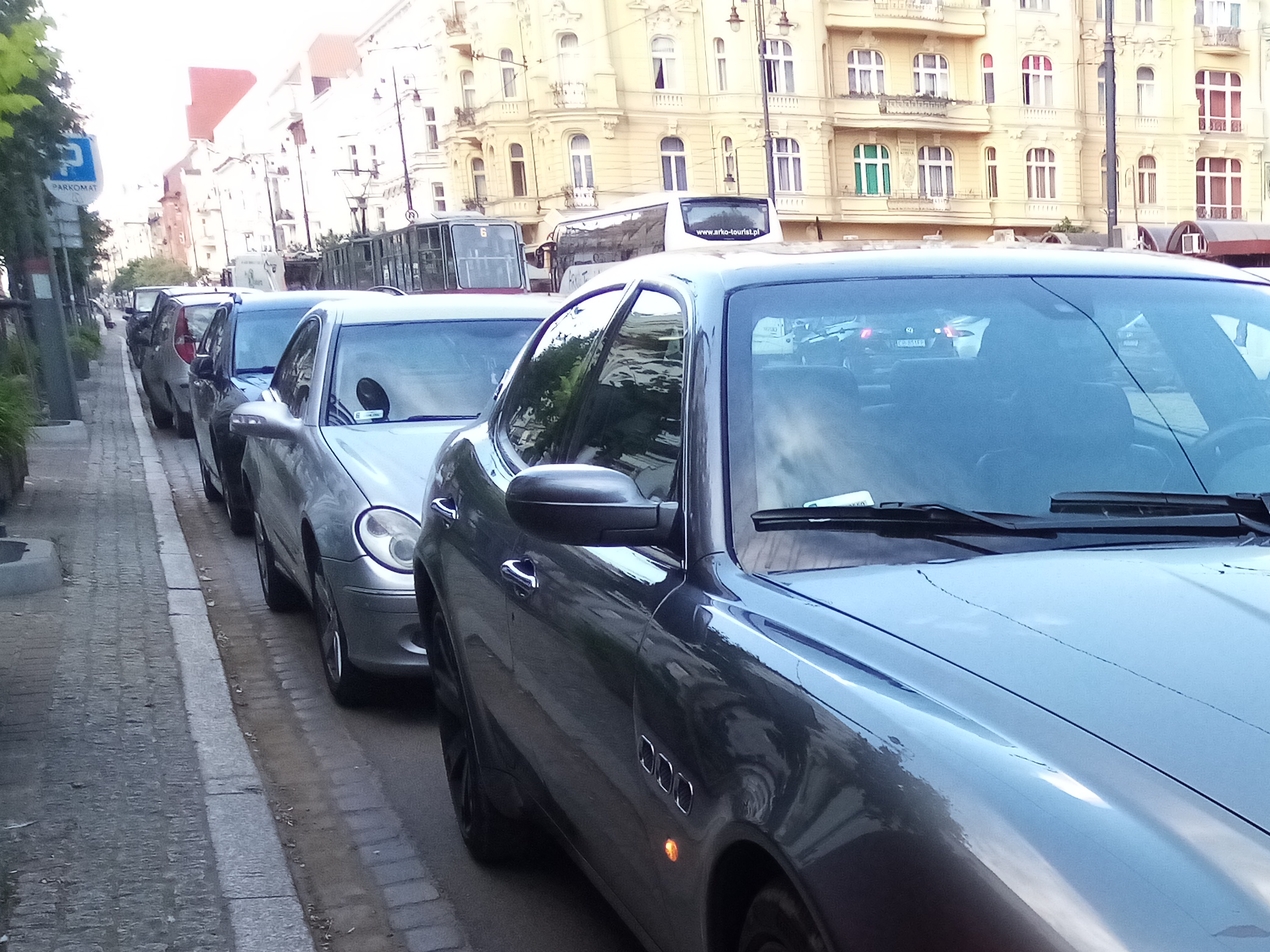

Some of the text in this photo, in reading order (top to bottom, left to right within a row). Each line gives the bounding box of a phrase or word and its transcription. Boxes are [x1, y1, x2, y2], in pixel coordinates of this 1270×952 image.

[52, 183, 97, 192] PARKOMAT
[480, 227, 488, 237] 6
[696, 228, 760, 237] www.arko-tourist.pl
